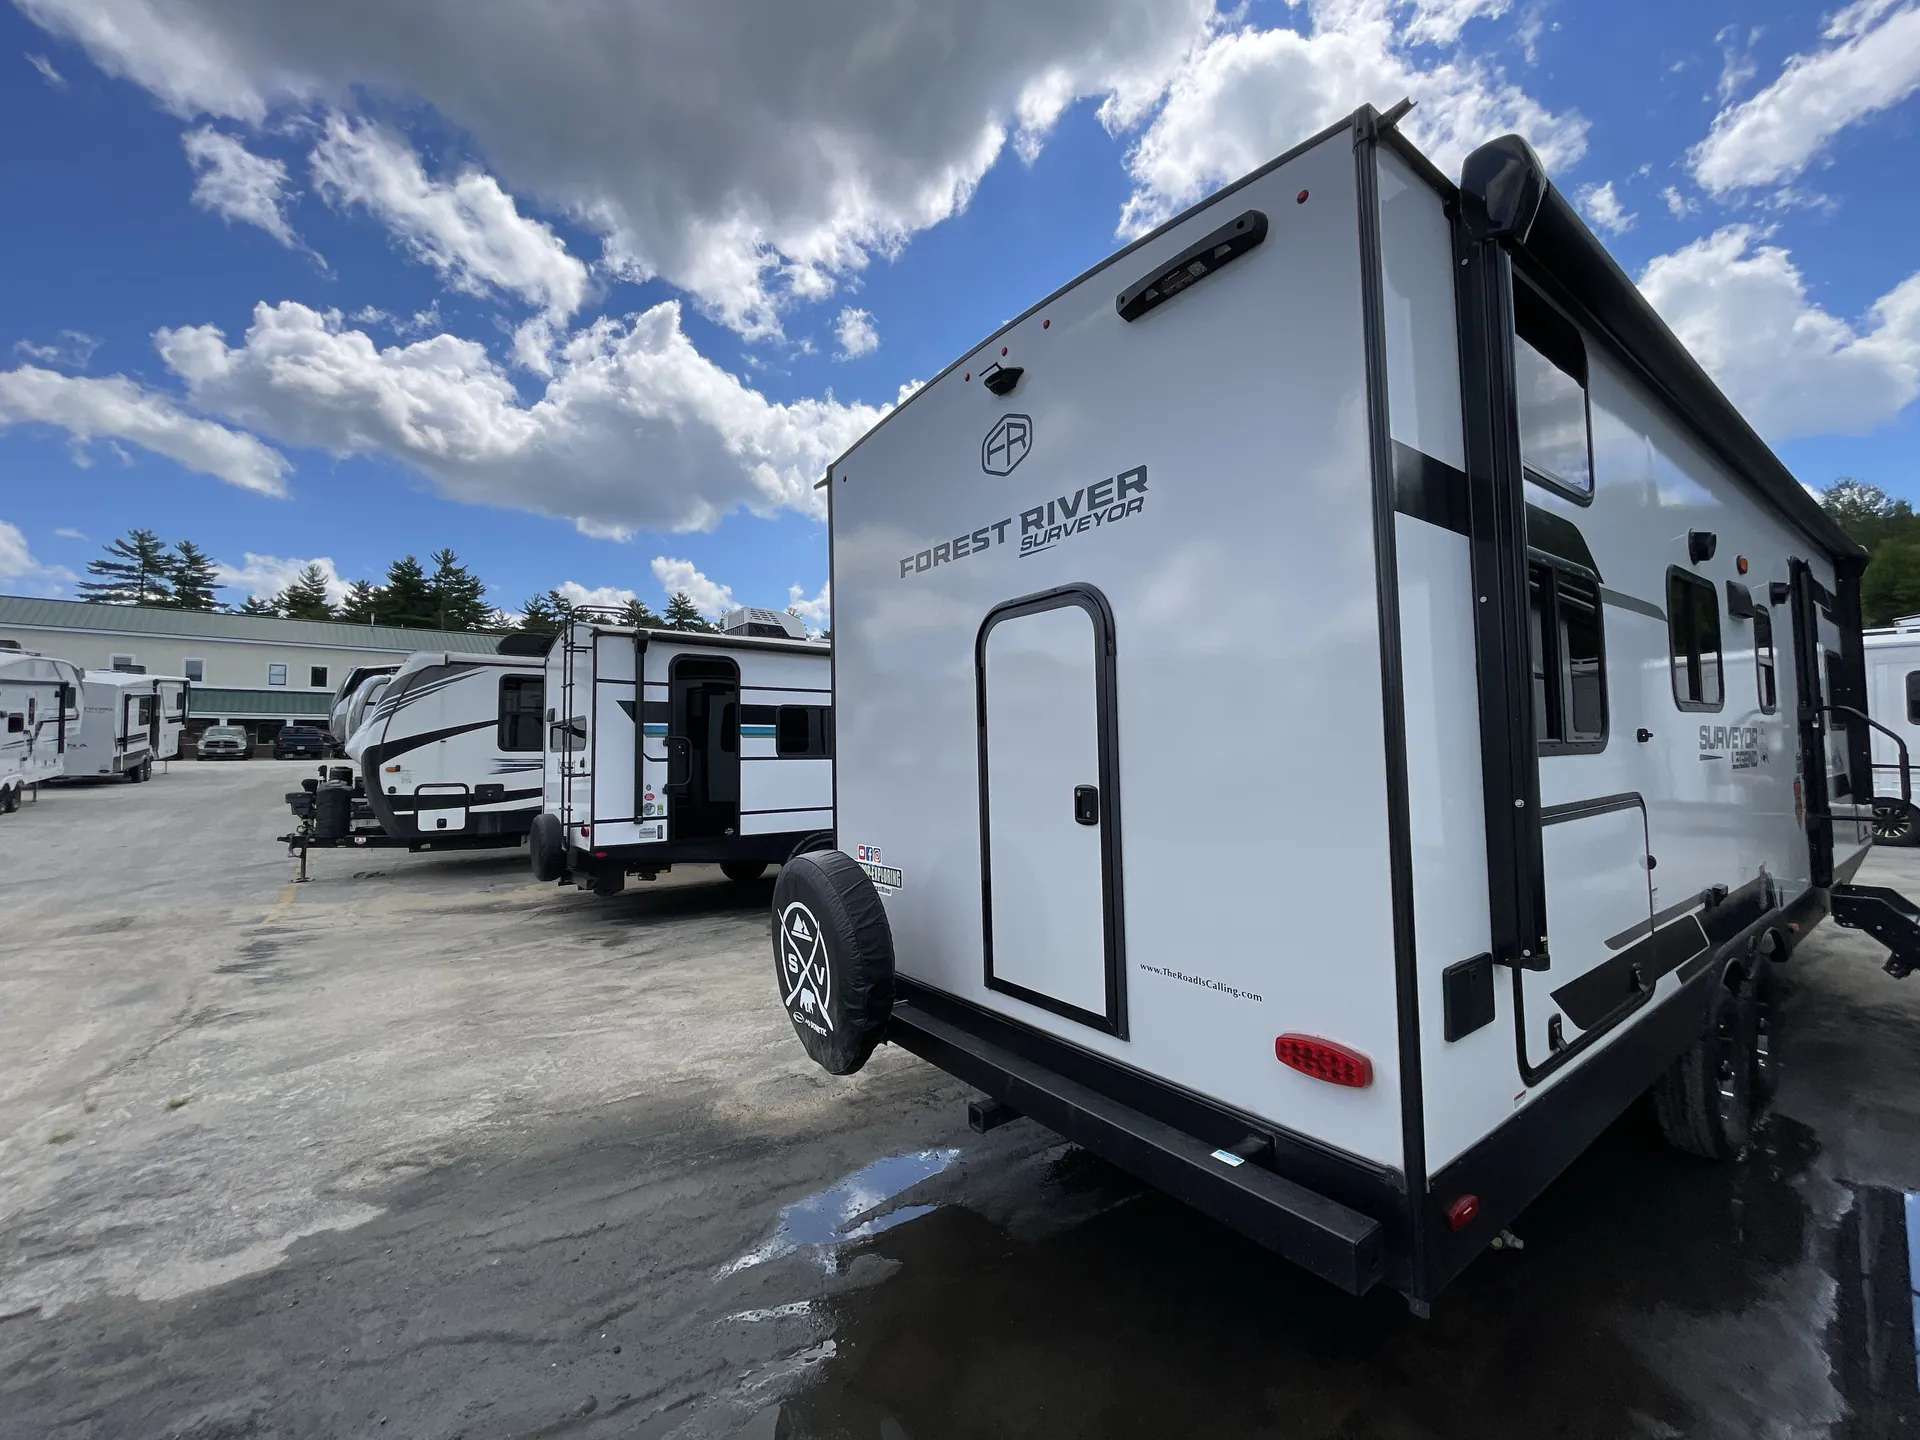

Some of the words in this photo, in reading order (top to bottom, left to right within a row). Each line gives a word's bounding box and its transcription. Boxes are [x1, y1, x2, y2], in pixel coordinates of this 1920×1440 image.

[899, 517, 1012, 579] FOREST
[1019, 464, 1149, 536] RIVER
[1020, 496, 1145, 552] SURVEYOR
[1699, 724, 1758, 750] SURVEYOR
[788, 953, 798, 974] S
[813, 963, 825, 986] V
[1139, 963, 1263, 1002] www.TheRoadIsCalling.com
